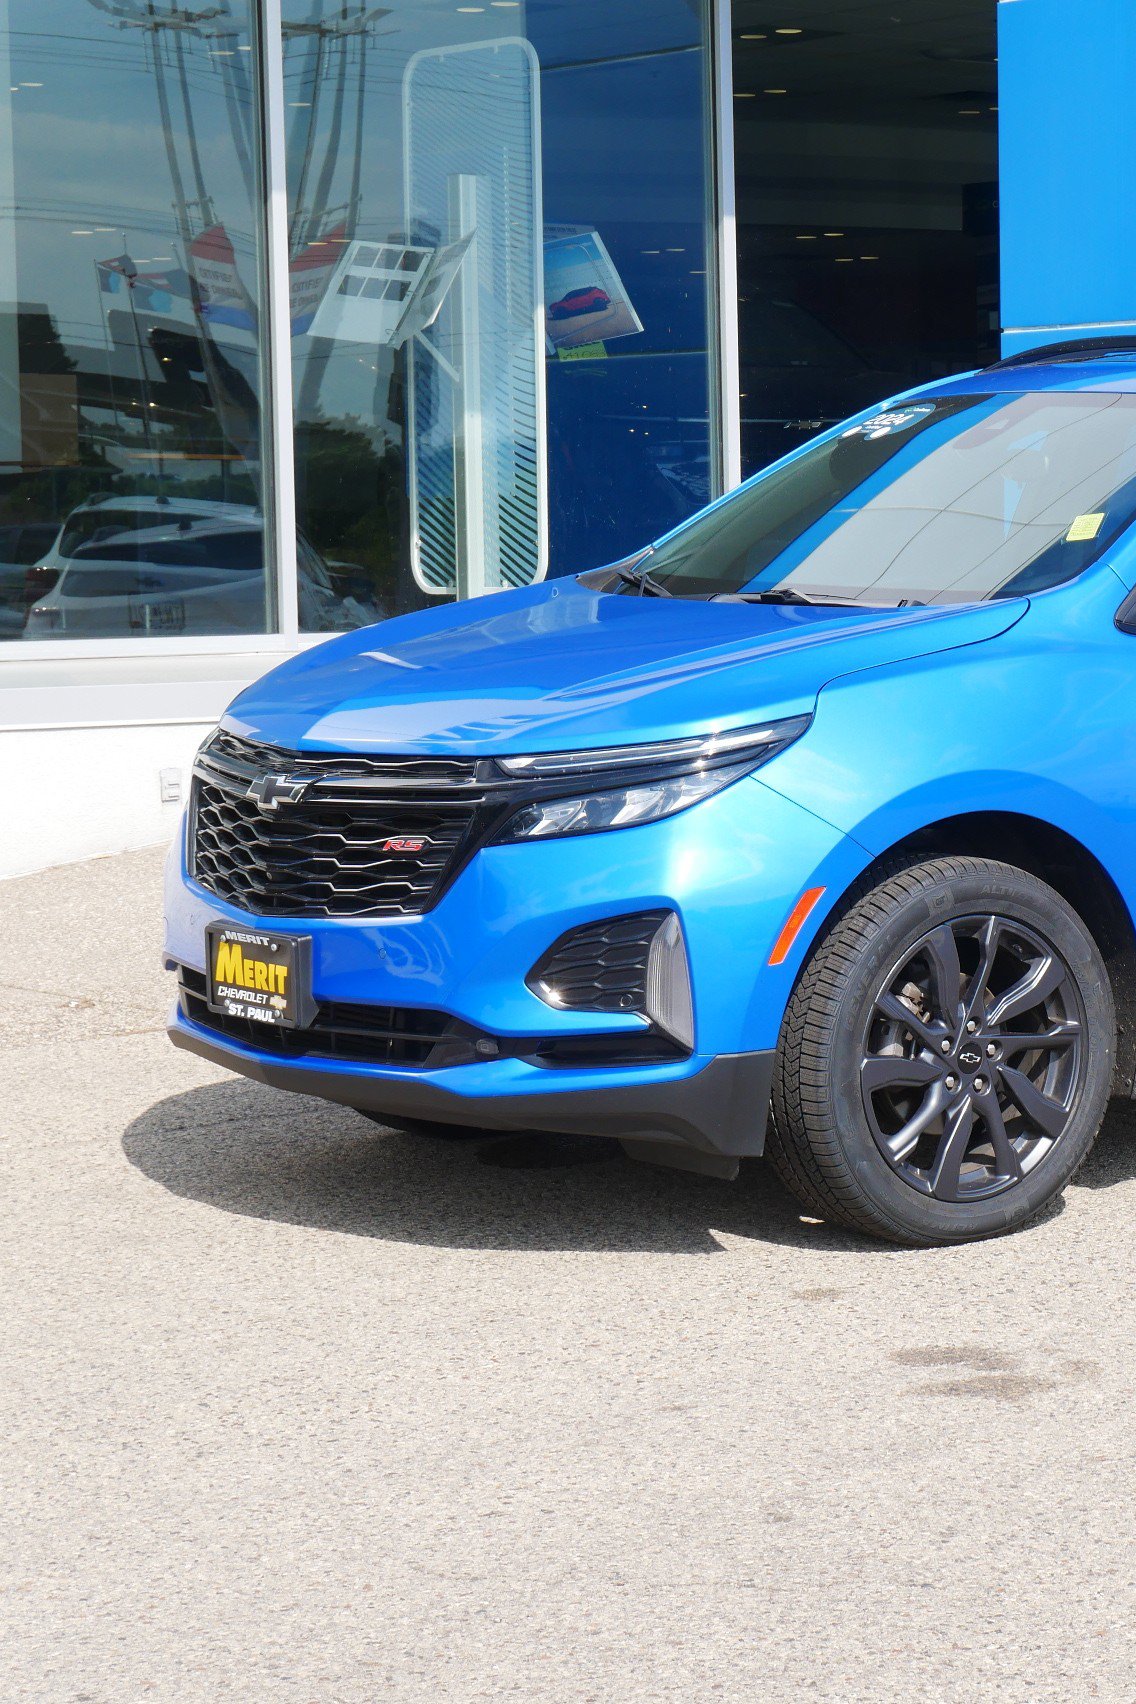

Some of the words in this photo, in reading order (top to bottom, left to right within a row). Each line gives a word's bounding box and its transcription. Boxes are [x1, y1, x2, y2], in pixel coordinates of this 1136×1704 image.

[382, 839, 424, 852] RS
[224, 930, 270, 946] MERIT
[215, 941, 288, 995] MERIT
[217, 985, 269, 1005] CHEVROLET
[228, 1003, 245, 1017] ST.
[247, 1007, 276, 1024] PAUL
